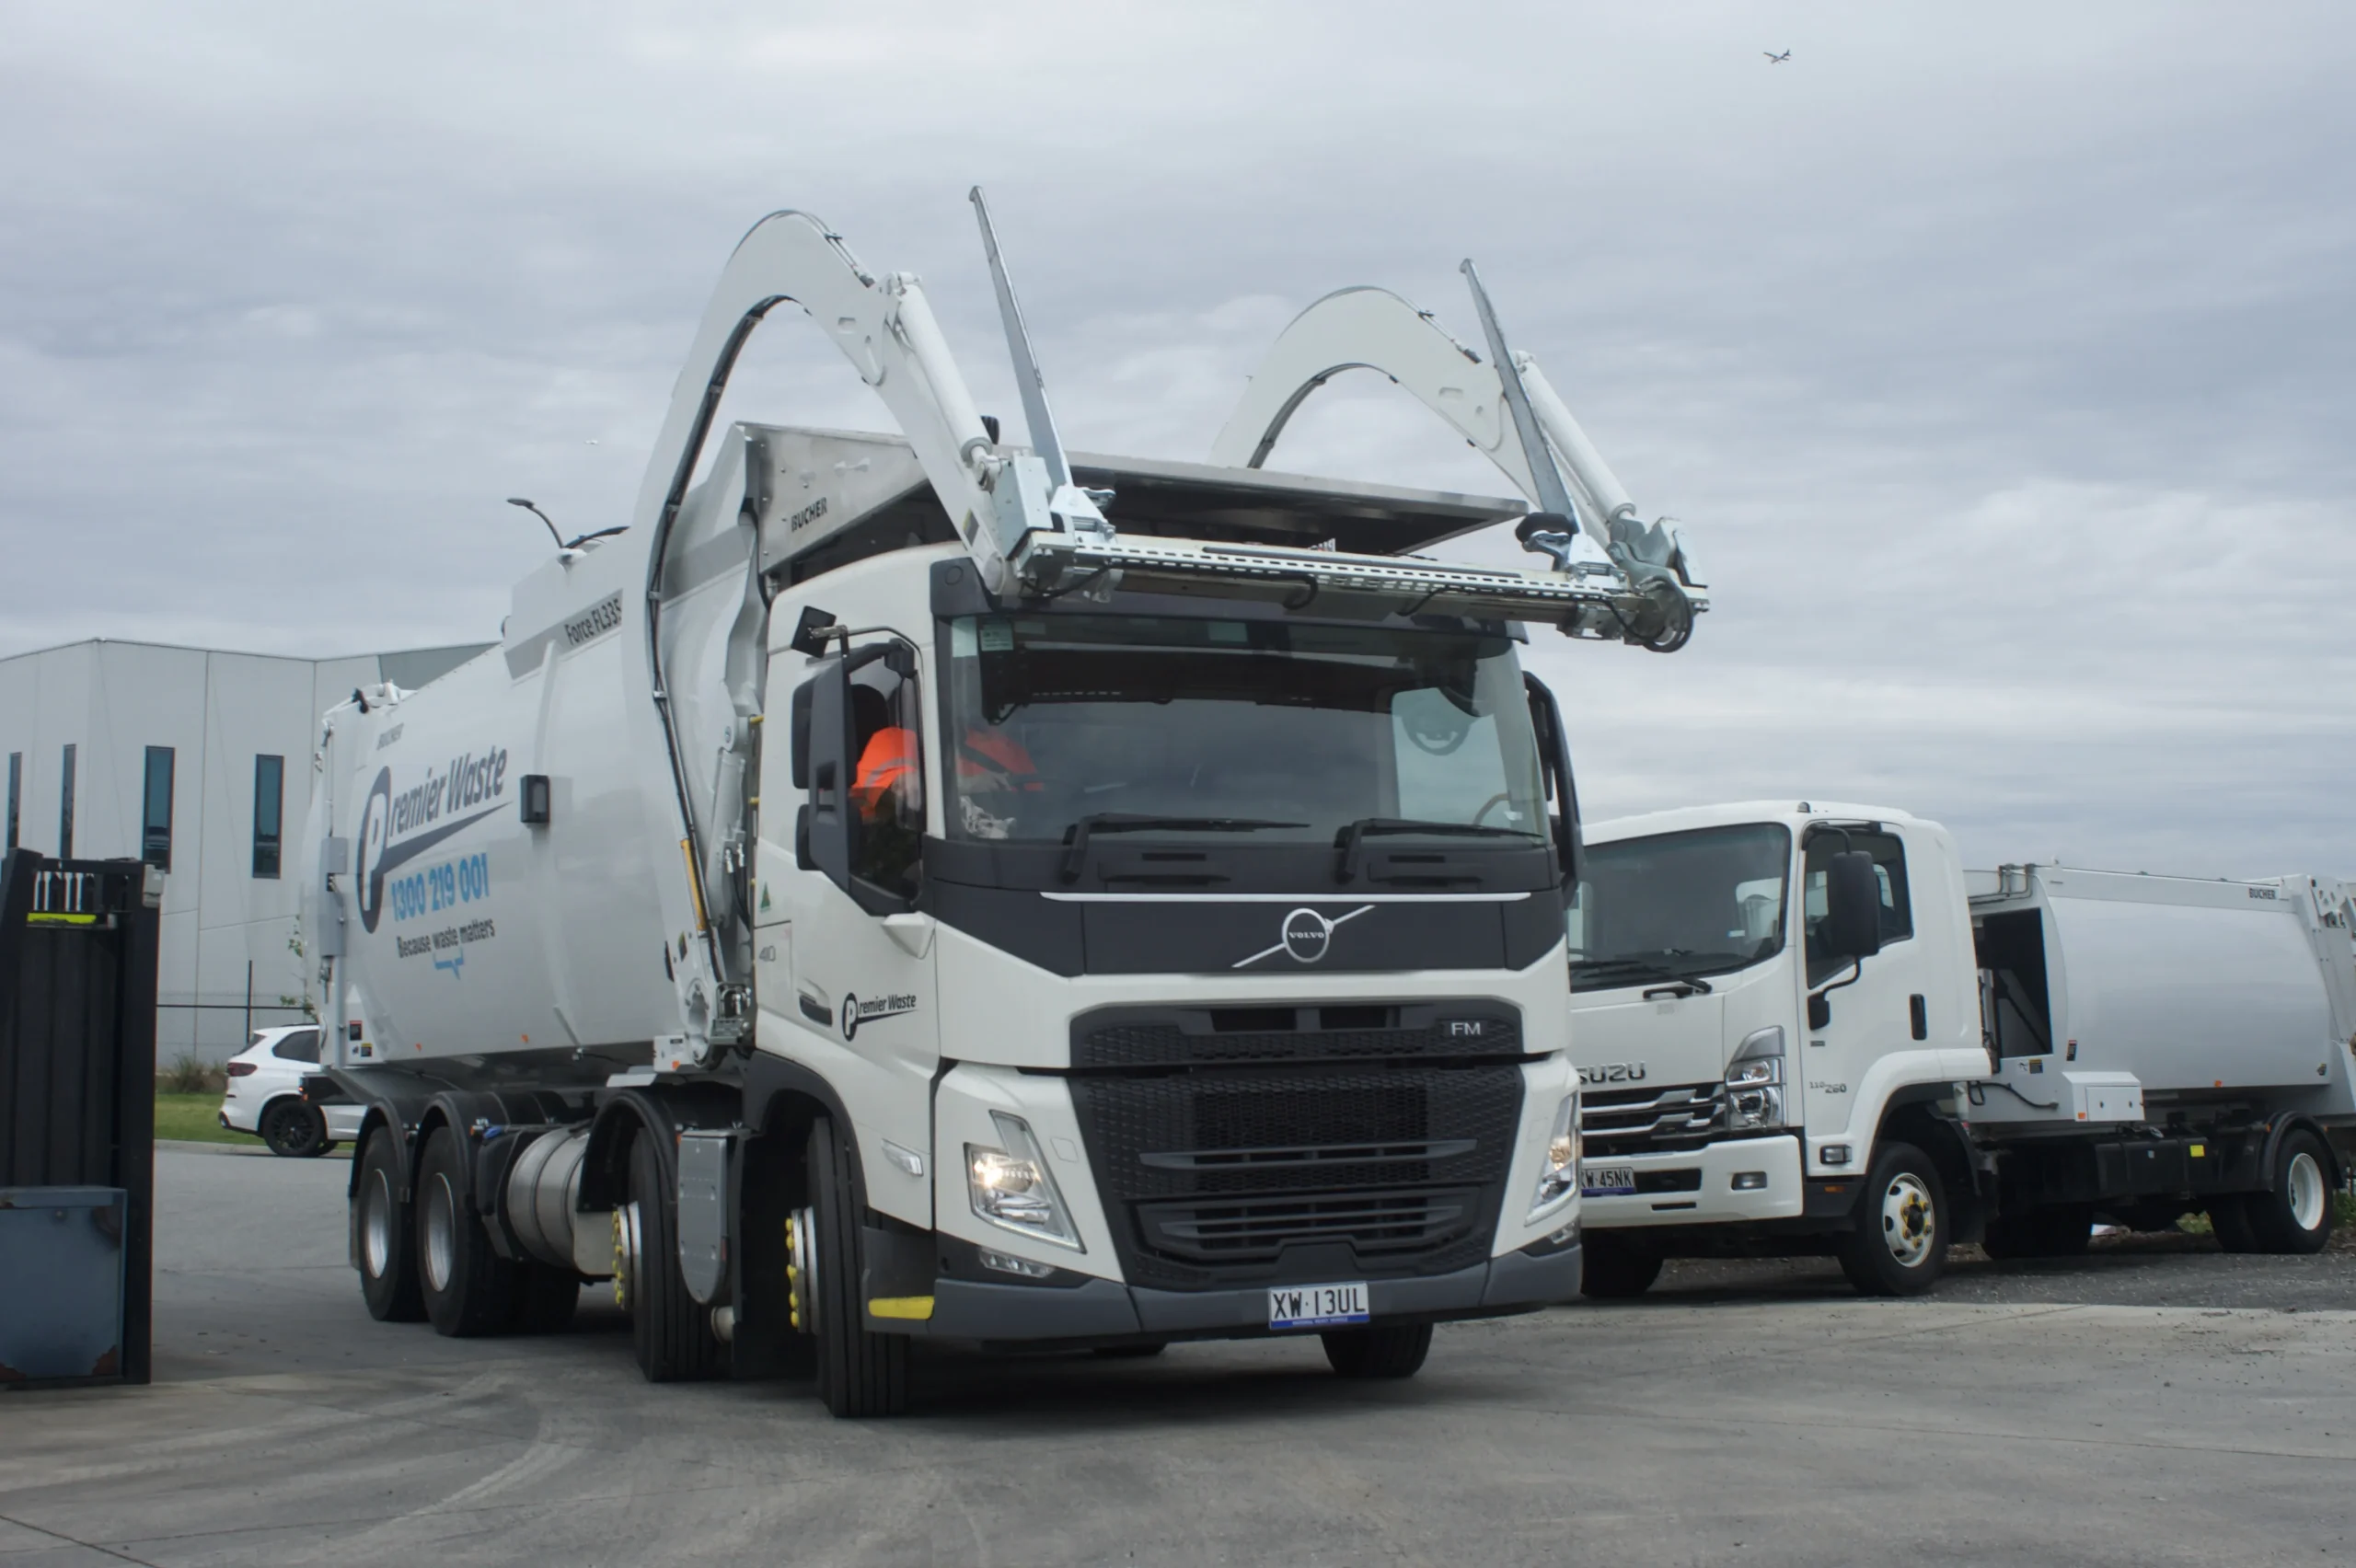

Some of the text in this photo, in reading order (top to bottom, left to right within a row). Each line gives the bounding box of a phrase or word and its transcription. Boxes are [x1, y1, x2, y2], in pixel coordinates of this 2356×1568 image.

[791, 497, 827, 533] BUCHER
[564, 598, 622, 645] Force FL335
[364, 745, 508, 911] Premier Waste
[391, 852, 490, 921] 1300 219 001
[2248, 888, 2276, 900] BUCHER
[397, 918, 495, 959] Because waste matters
[845, 994, 917, 1036] Premier Waste
[1451, 1021, 1481, 1036] FM
[1576, 1060, 1646, 1085] SUZU
